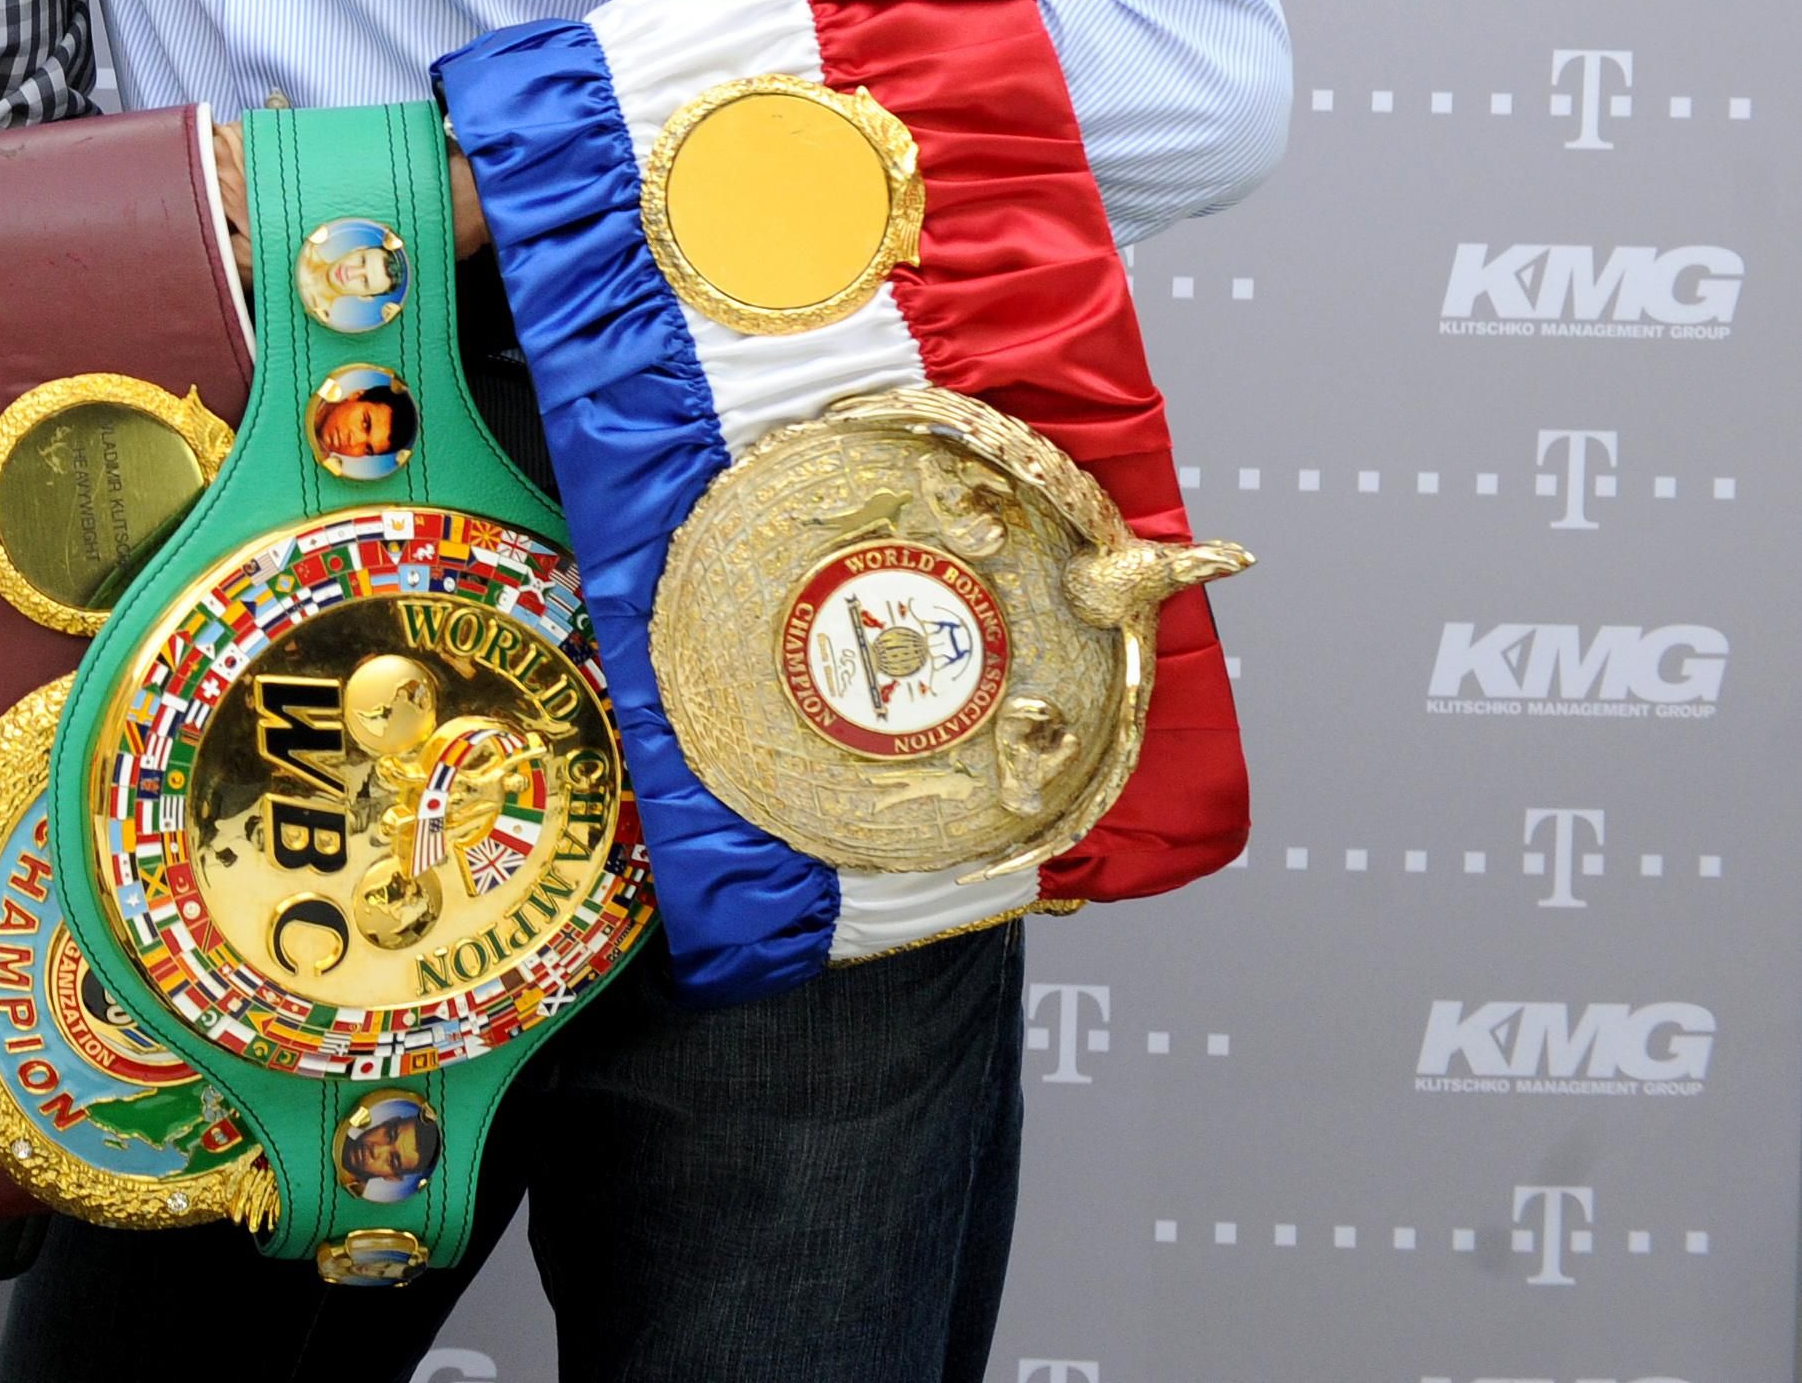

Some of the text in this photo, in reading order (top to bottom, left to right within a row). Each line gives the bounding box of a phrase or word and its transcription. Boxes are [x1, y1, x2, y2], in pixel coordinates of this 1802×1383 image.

[1552, 50, 1632, 148] T
[1439, 320, 1731, 340] KLITSCHKO MANAGEMENT GROUP
[1442, 243, 1744, 323] KMG
[71, 446, 101, 562] HEAVYWEIGHT
[1537, 431, 1616, 528] T
[785, 601, 838, 729] CHAMPION
[844, 547, 1003, 754] WORLD BOXING ASSOCIATION
[1428, 623, 1728, 703] KMG
[1426, 700, 1715, 718] KLITSCHKO MANAGEMENT GROUP
[254, 673, 352, 978] WBC
[397, 597, 609, 996] WORLD CHAMPION
[1525, 809, 1604, 906] T
[58, 940, 116, 1068] GANIZATION
[1028, 984, 1109, 1083] T
[1417, 1001, 1715, 1080] KMG
[1415, 1078, 1703, 1096] KLITSCHKO MANAGEMENT GROUP
[1514, 1187, 1592, 1283] T
